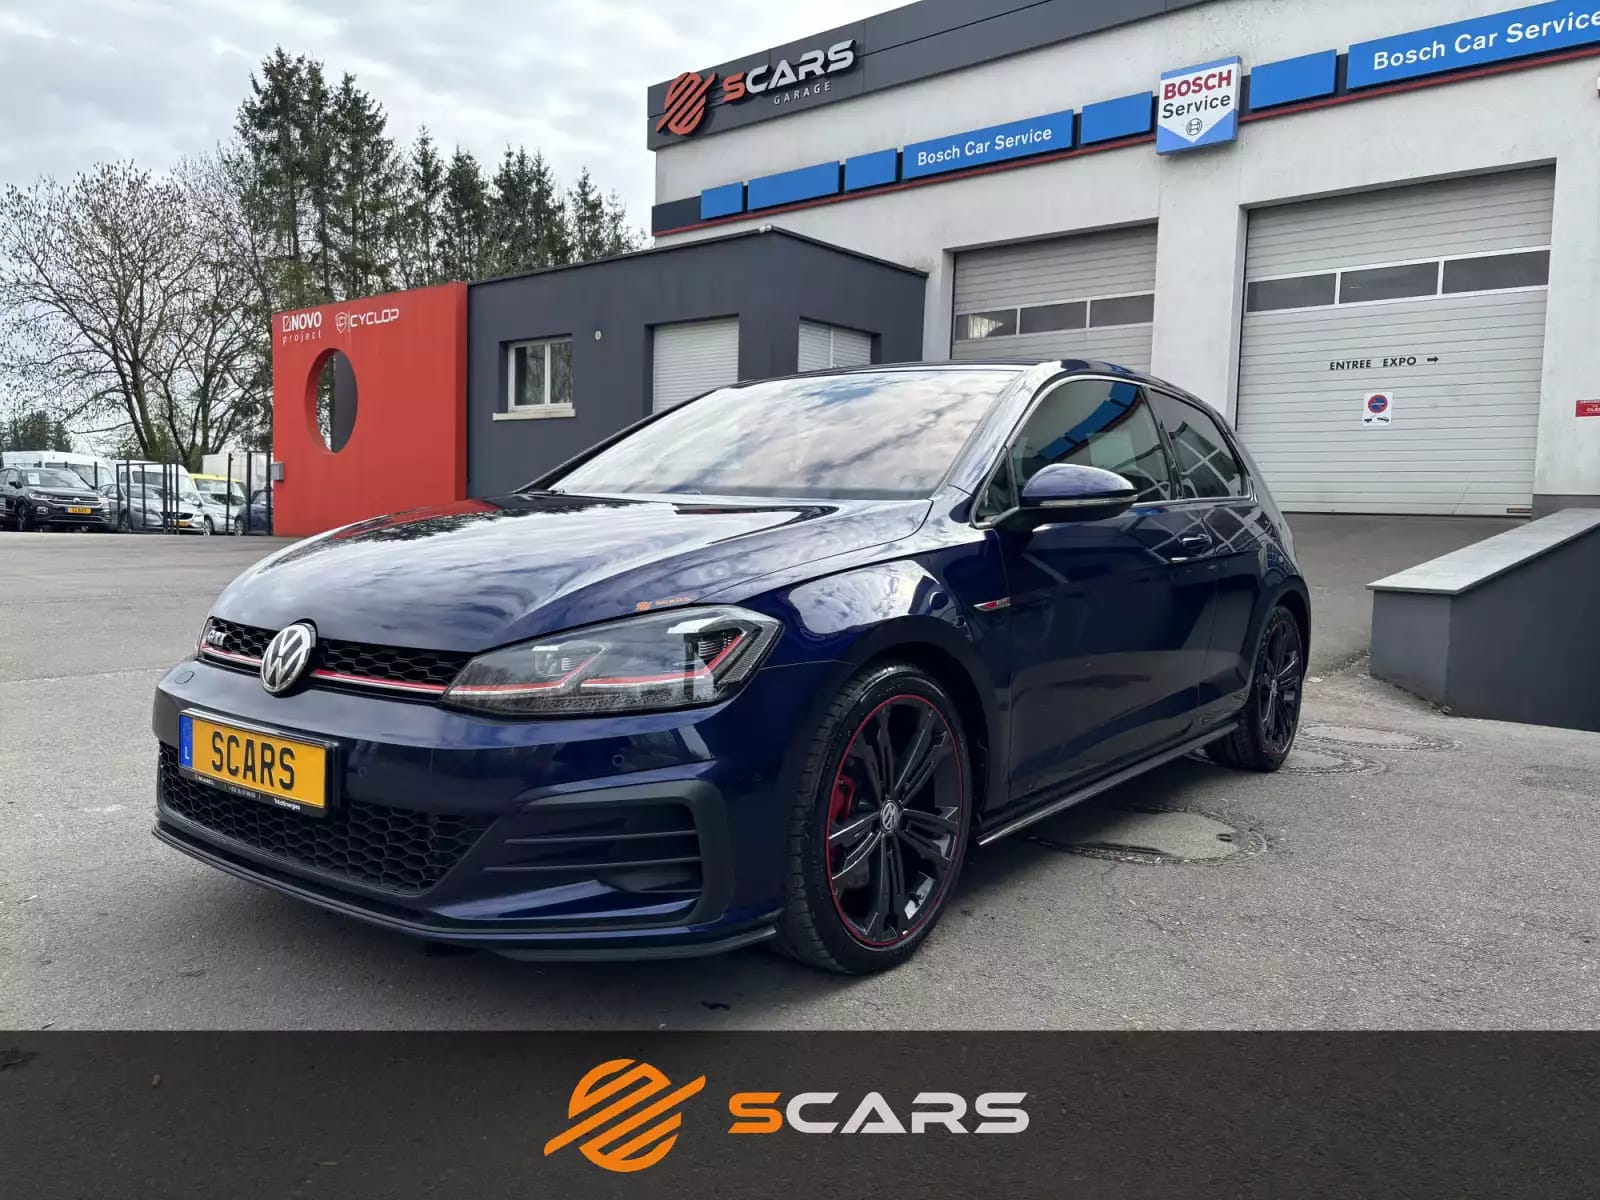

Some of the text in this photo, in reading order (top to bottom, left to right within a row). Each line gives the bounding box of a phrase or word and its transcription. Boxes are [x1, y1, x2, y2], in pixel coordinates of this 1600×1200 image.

[1373, 8, 1600, 71] Bosch Car Service
[723, 39, 857, 102] SCARS
[1163, 69, 1232, 101] BOSCH
[774, 82, 832, 105] GARAGE
[1162, 93, 1231, 120] Service
[917, 126, 1053, 166] Bosch Car Service
[350, 308, 399, 328] CYCLOP
[282, 330, 322, 345] project
[1329, 356, 1417, 371] ENTREE EXPO
[211, 731, 296, 790] SCARS
